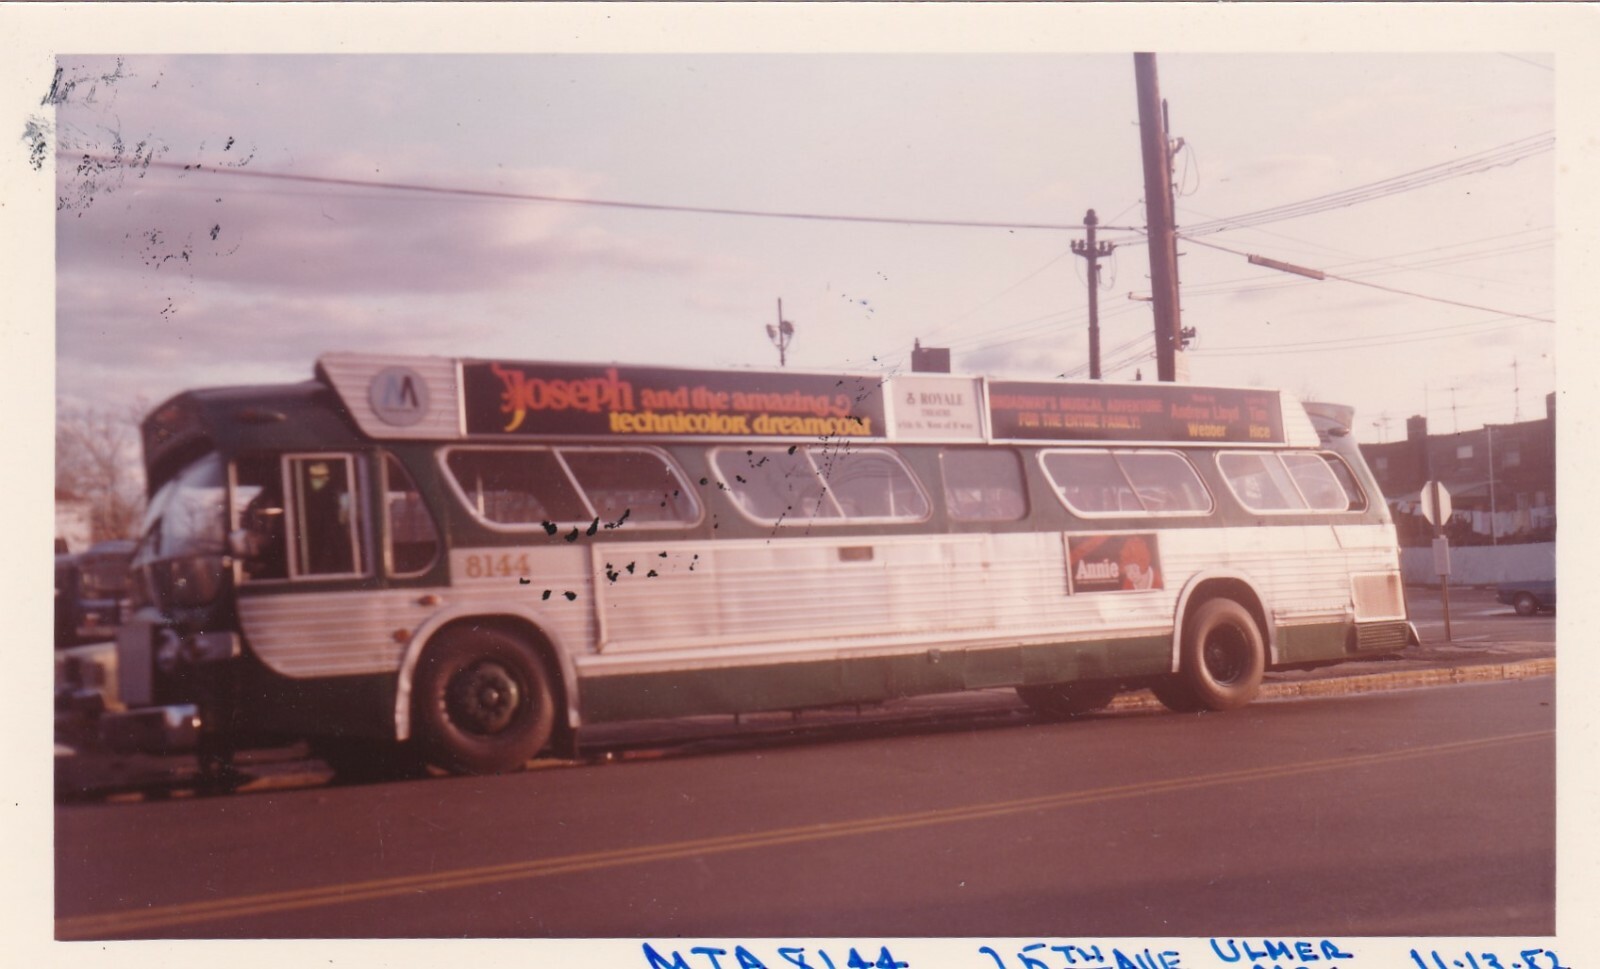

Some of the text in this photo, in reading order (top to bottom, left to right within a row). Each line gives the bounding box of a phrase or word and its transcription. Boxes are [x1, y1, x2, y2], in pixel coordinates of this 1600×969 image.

[490, 361, 851, 432] Joseph and the amazing
[920, 393, 964, 406] ROYALE
[1059, 395, 1105, 412] MUSICAL
[1107, 398, 1164, 414] ADVENTURE
[1018, 412, 1040, 427] FOR
[1042, 413, 1063, 428] THE
[1064, 413, 1100, 429] ENTIRE
[1171, 402, 1240, 422] Andrew Lloyd
[1249, 406, 1268, 420] Tim
[752, 413, 872, 436] dreamcoat
[1187, 422, 1226, 438] Webber
[1249, 424, 1271, 439] Rice
[465, 553, 531, 578] 8144
[1075, 558, 1120, 580] Annie
[643, 942, 768, 969] MTA
[1209, 938, 1355, 963] ULMER
